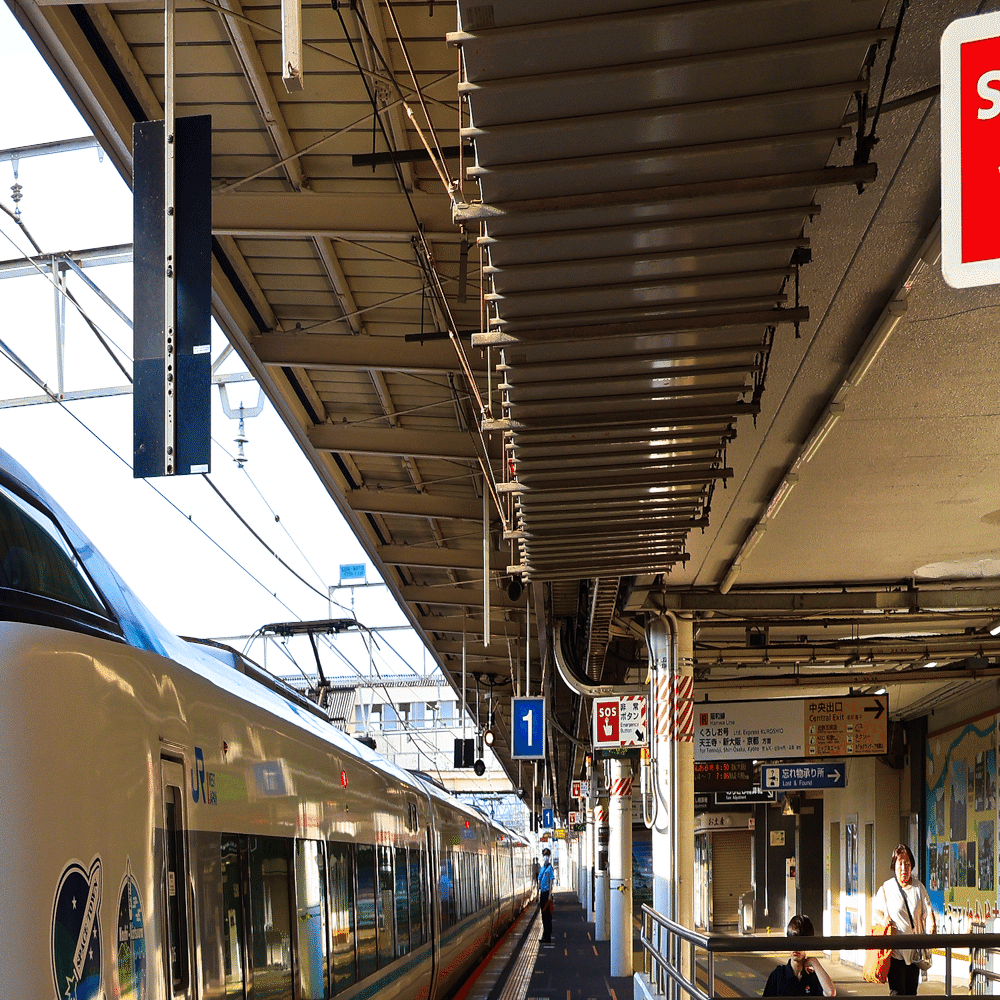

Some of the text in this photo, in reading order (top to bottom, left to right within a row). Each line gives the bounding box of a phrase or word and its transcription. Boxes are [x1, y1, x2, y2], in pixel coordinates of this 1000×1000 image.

[599, 706, 617, 717] SOS
[809, 702, 843, 713] 中央出口
[620, 712, 639, 720] ボタン
[809, 714, 832, 722] Central
[832, 713, 844, 721] Exit
[522, 709, 533, 747] 1
[699, 728, 729, 737] くろしお号
[190, 746, 206, 804] JR
[782, 767, 825, 779] 忘れ物承り所
